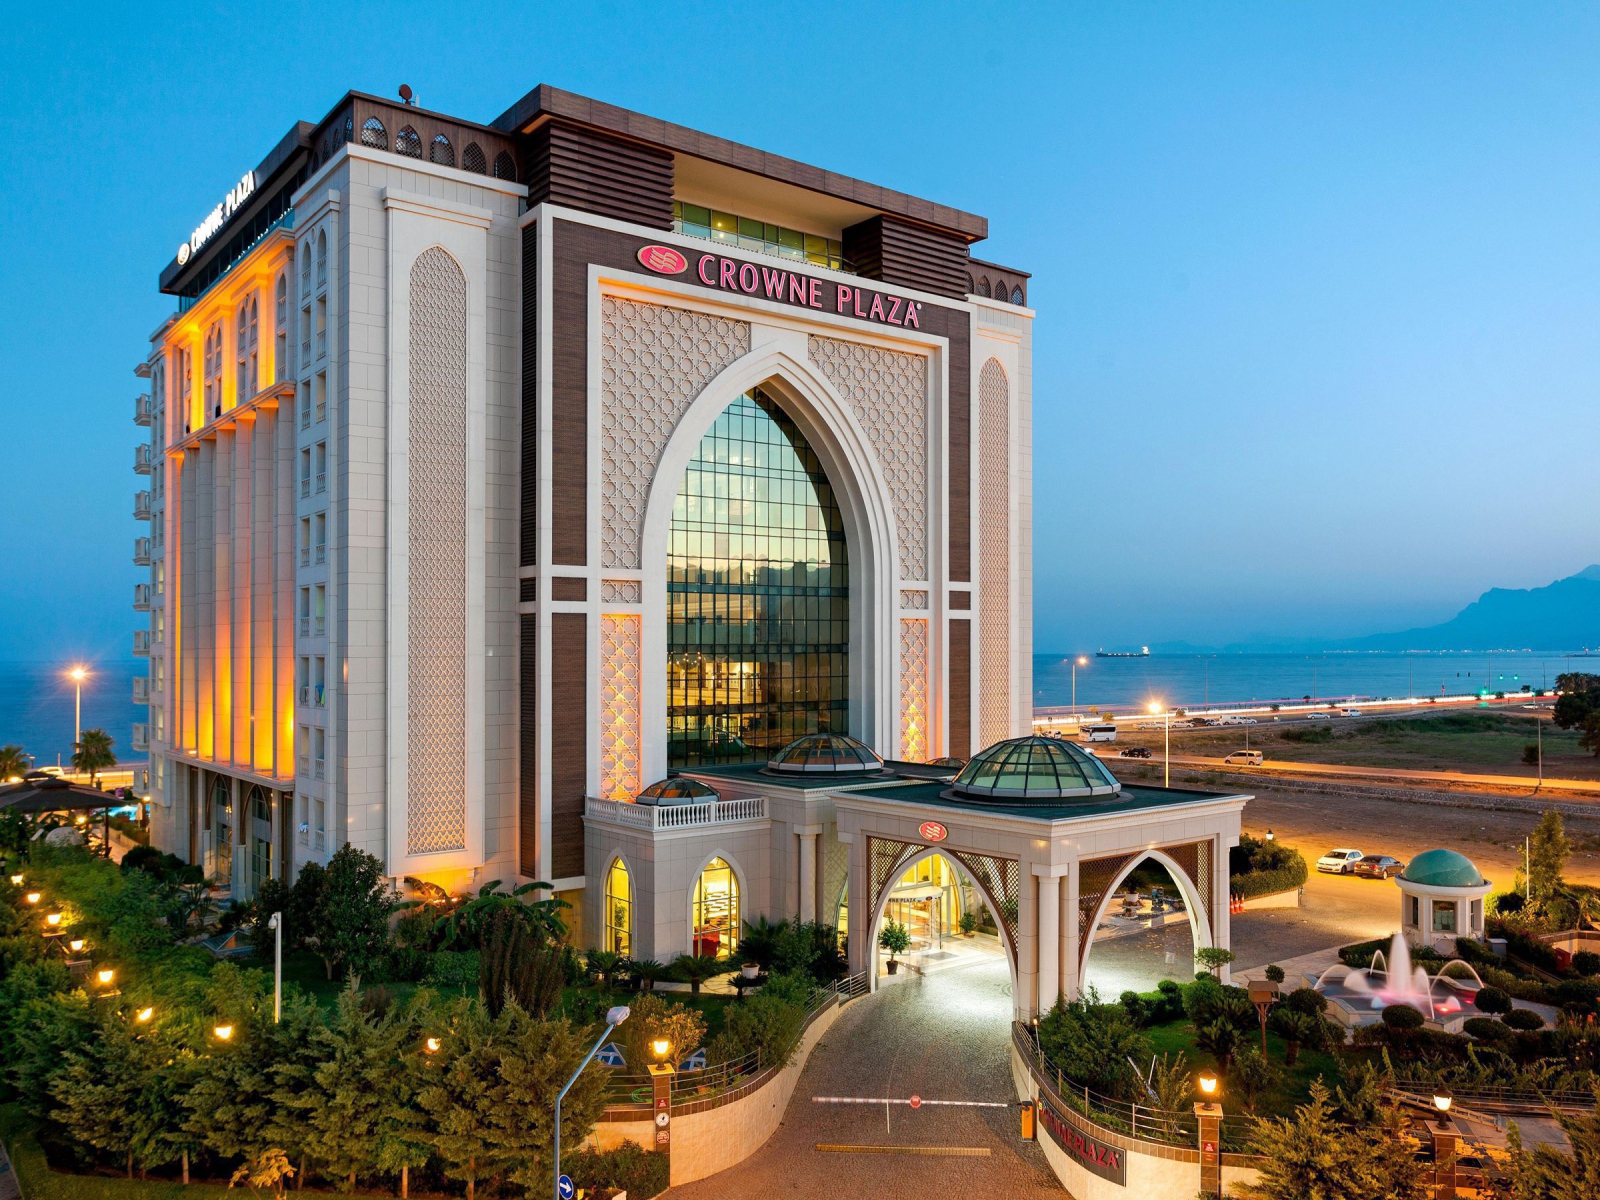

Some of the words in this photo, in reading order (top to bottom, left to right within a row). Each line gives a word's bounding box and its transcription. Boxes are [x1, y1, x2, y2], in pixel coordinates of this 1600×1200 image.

[226, 170, 254, 216] PLAZA
[698, 254, 822, 308] CROWNE
[837, 284, 920, 328] PLAZA
[1074, 1134, 1117, 1170] PLAZA
